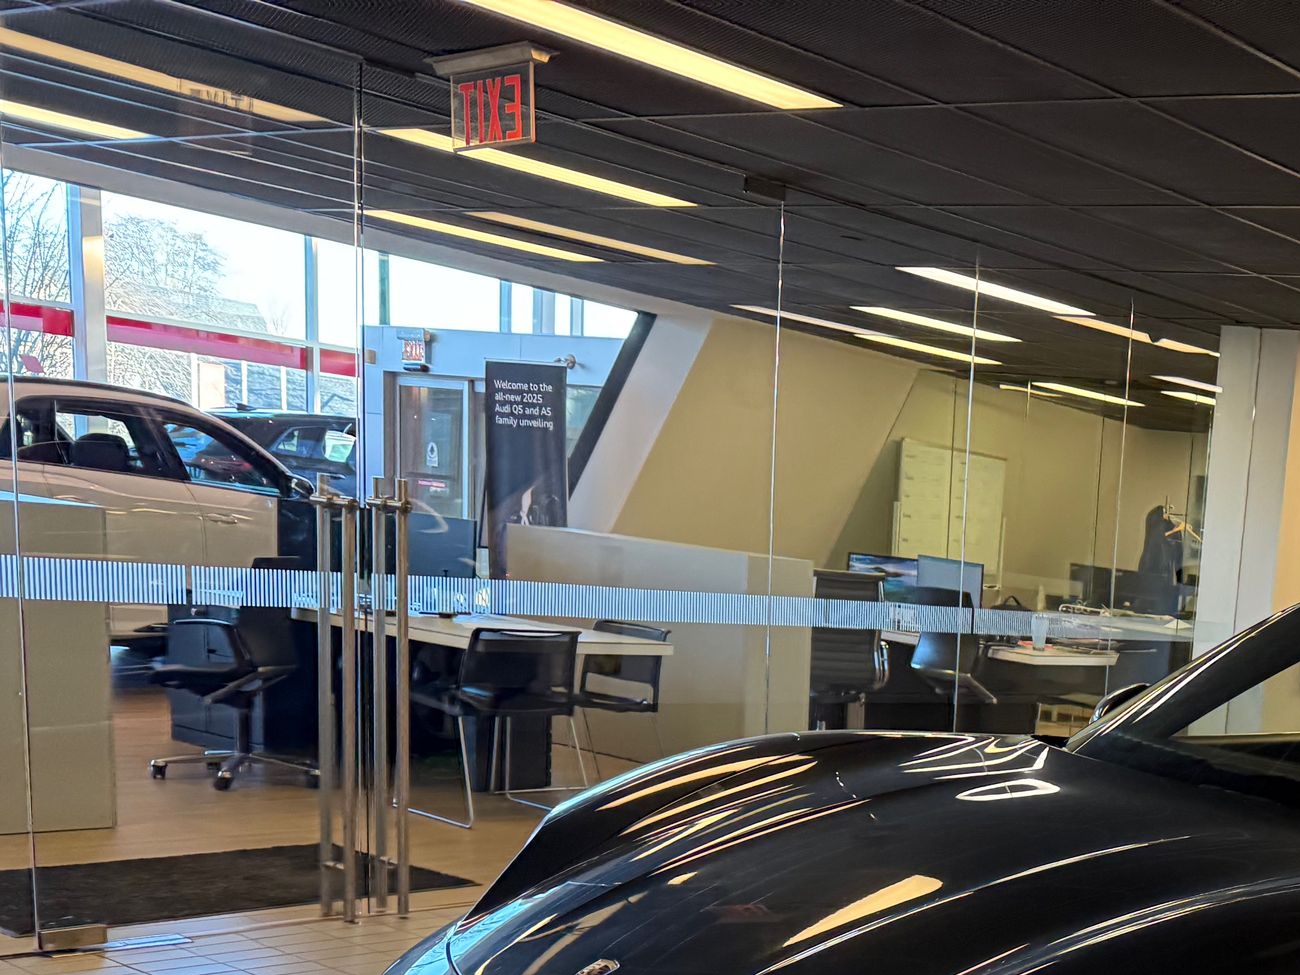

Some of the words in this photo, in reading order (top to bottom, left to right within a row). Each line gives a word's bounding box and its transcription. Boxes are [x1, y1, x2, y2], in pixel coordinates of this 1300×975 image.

[494, 380, 528, 390] Welcome
[530, 382, 538, 391] to
[540, 382, 553, 392] the
[494, 392, 521, 401] all-new
[523, 393, 543, 403] 2025
[494, 403, 511, 413] Audi
[512, 404, 523, 415] Q5
[525, 406, 539, 415] and
[540, 407, 552, 416] A5
[495, 415, 518, 428] family
[519, 418, 554, 430] unveiling
